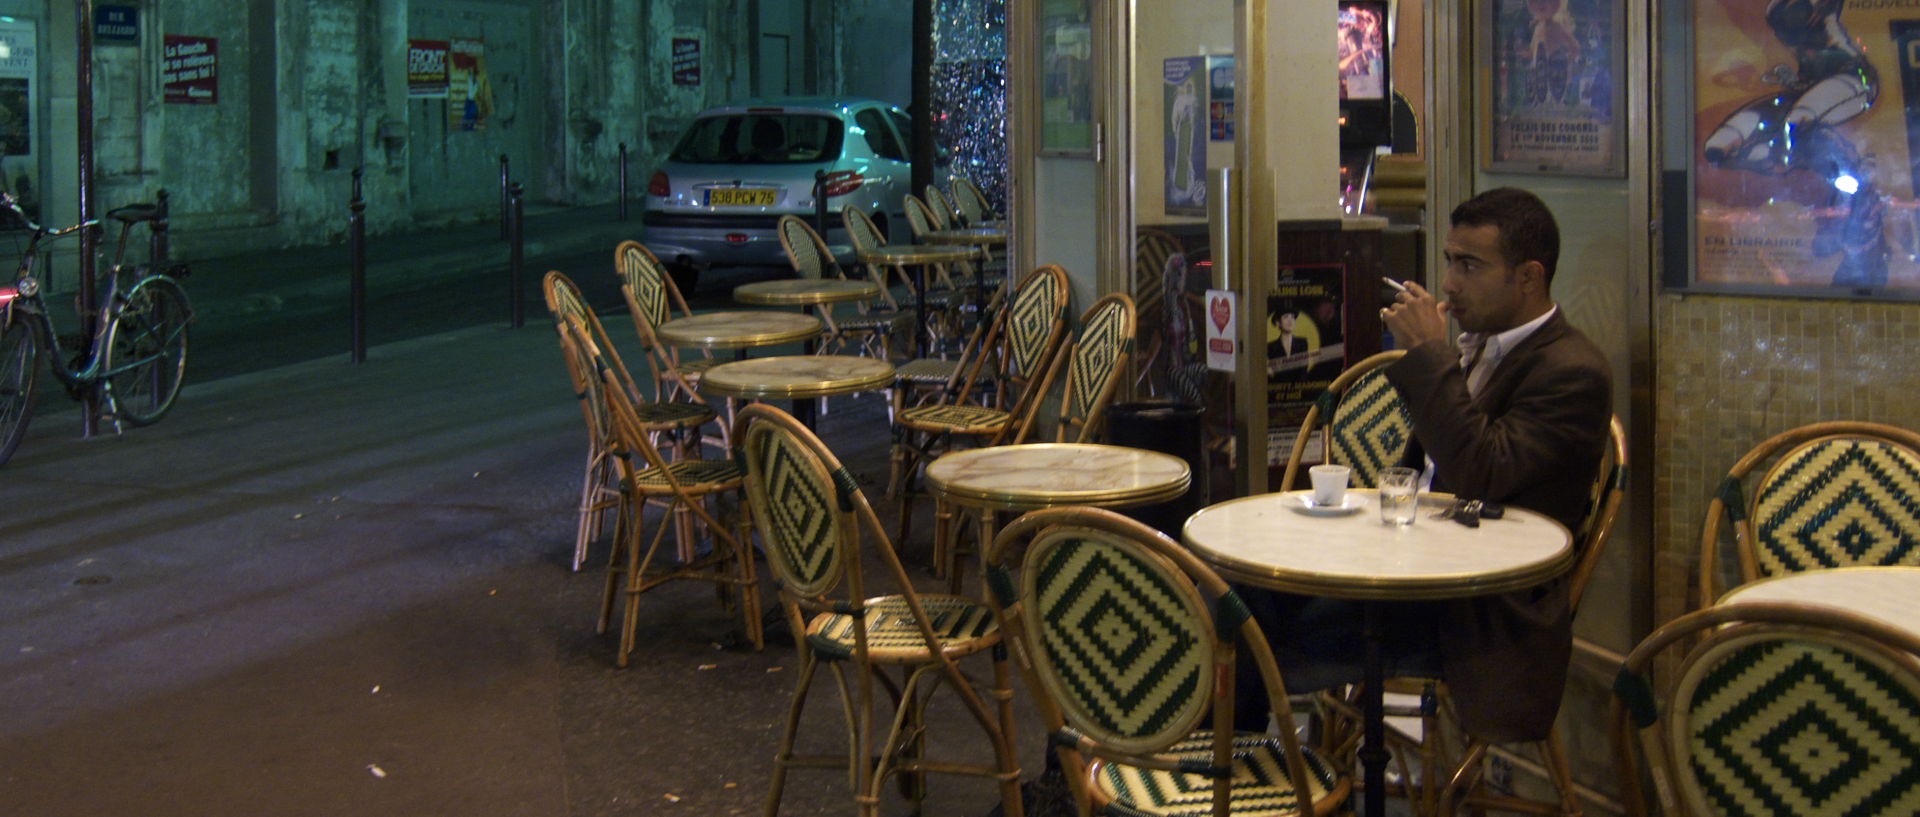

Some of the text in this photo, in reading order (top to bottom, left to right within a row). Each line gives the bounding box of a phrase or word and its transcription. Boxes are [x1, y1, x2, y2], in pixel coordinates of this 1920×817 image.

[165, 41, 208, 58] La Gauche
[409, 48, 446, 65] FRONT
[1511, 122, 1538, 132] PALAIS
[1541, 122, 1556, 132] DES
[1535, 134, 1577, 143] NOVEMBRE
[759, 190, 775, 206] 75
[1704, 235, 1802, 247] EN LIBRAIRIE
